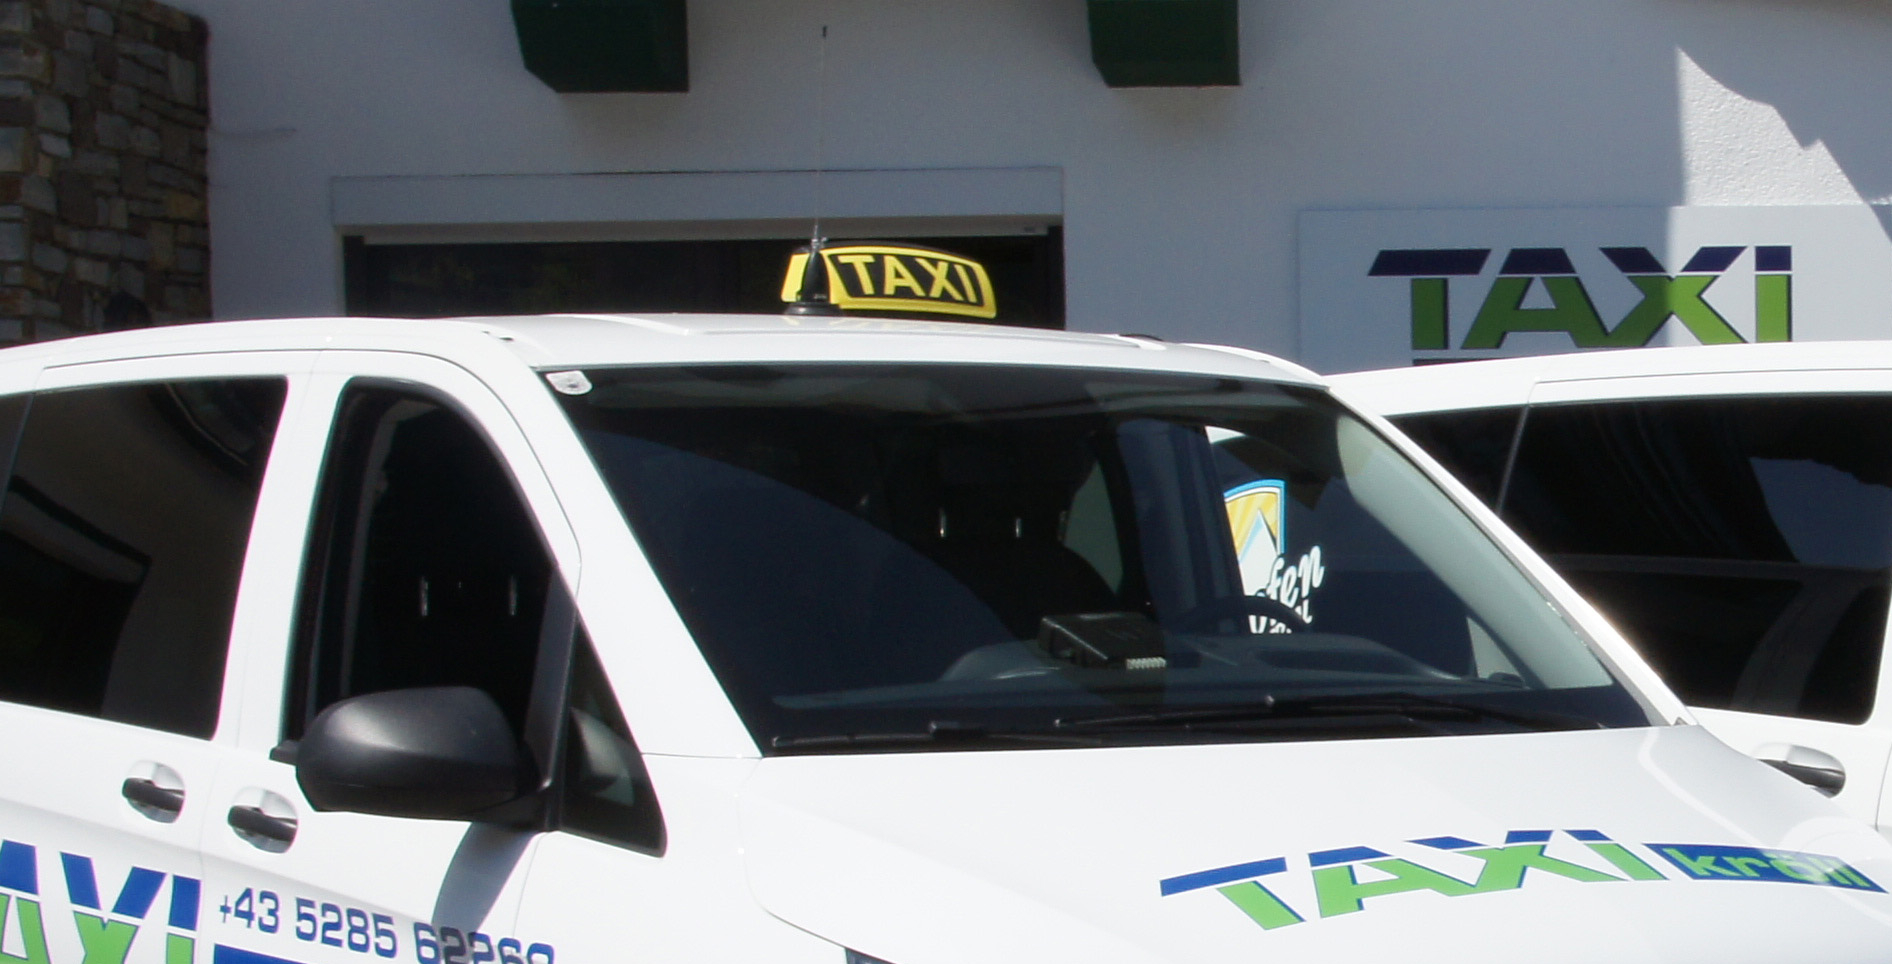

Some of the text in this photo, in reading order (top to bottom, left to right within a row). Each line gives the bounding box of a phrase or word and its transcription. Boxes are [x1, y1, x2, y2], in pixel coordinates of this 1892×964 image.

[837, 254, 978, 304] TAXI
[1367, 244, 1793, 350] TAXI
[219, 886, 281, 934] +43
[295, 896, 399, 959] 5285
[1159, 828, 1872, 931] TAXI kröll
